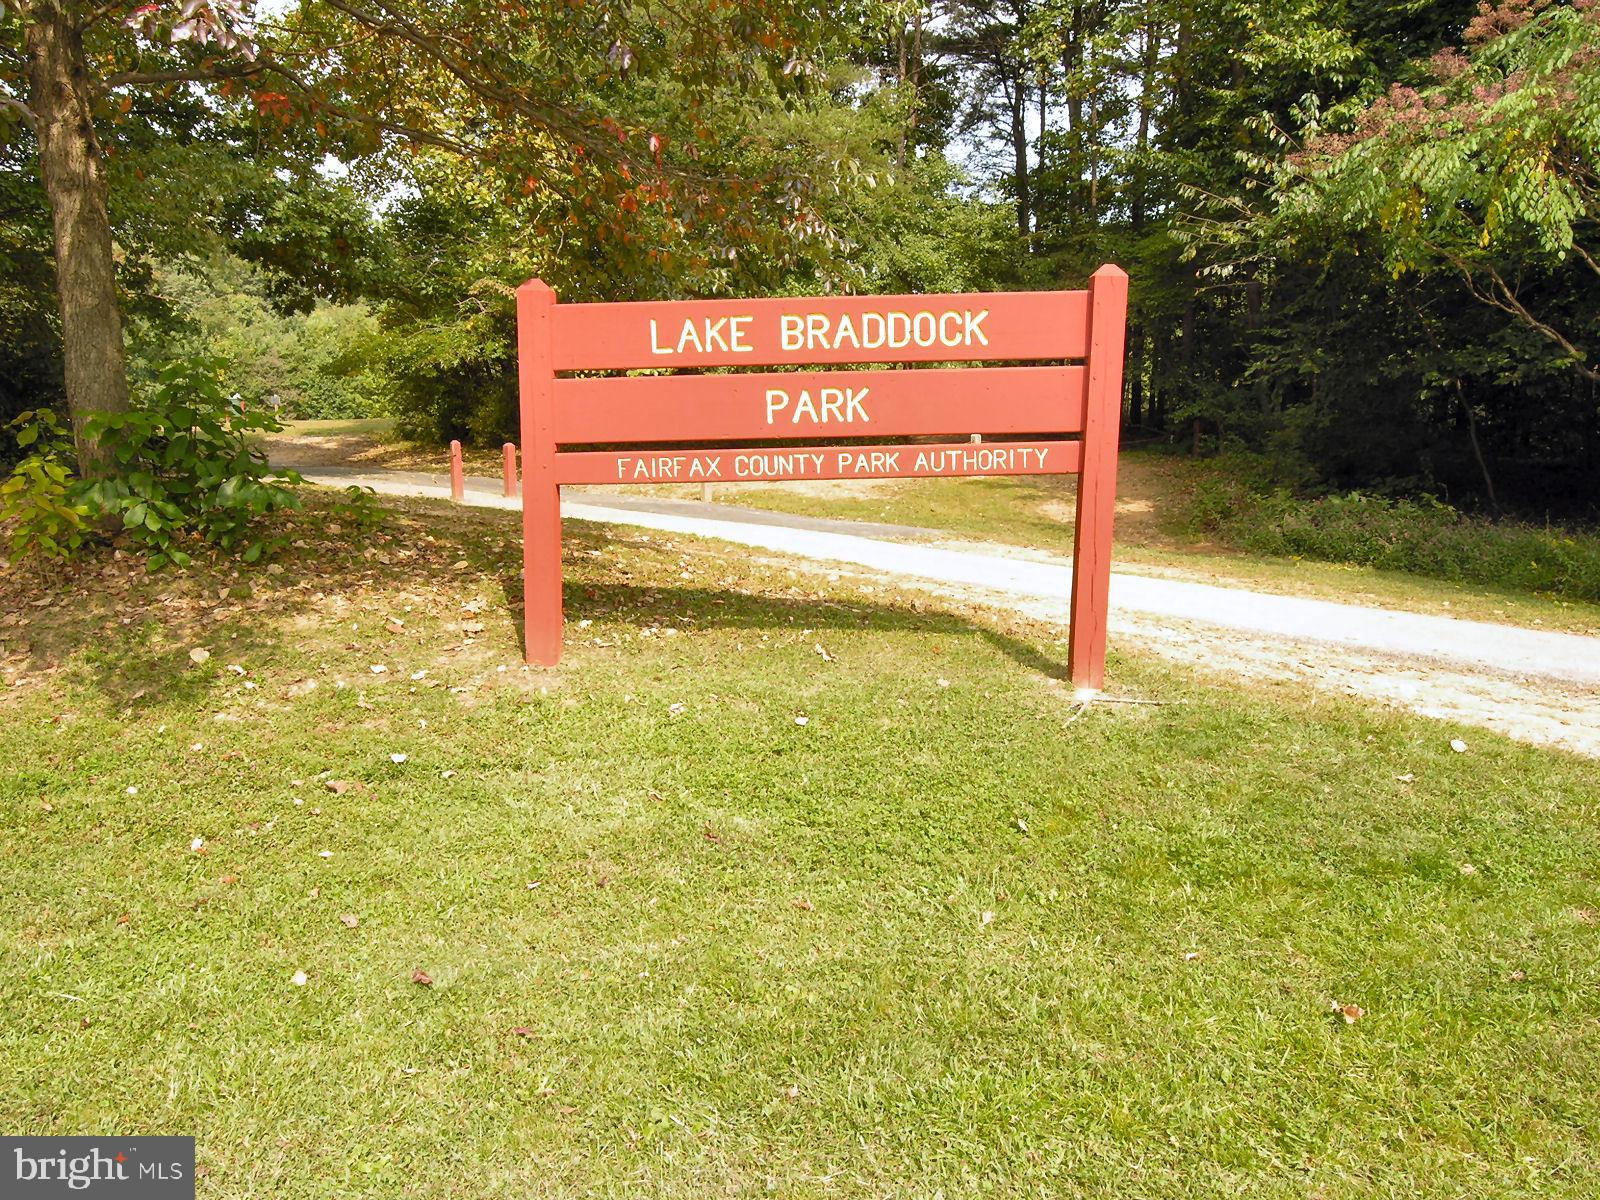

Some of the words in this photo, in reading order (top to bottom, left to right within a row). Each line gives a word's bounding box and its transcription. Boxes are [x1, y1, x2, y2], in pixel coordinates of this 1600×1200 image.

[649, 315, 754, 355] LAKE
[780, 309, 990, 351] BRADDOCK
[765, 387, 870, 425] PARK
[616, 456, 722, 479] FAIRFAX
[734, 453, 825, 477] COUNTY
[837, 451, 901, 474] PARK
[913, 447, 1050, 472] AUTHORITY
